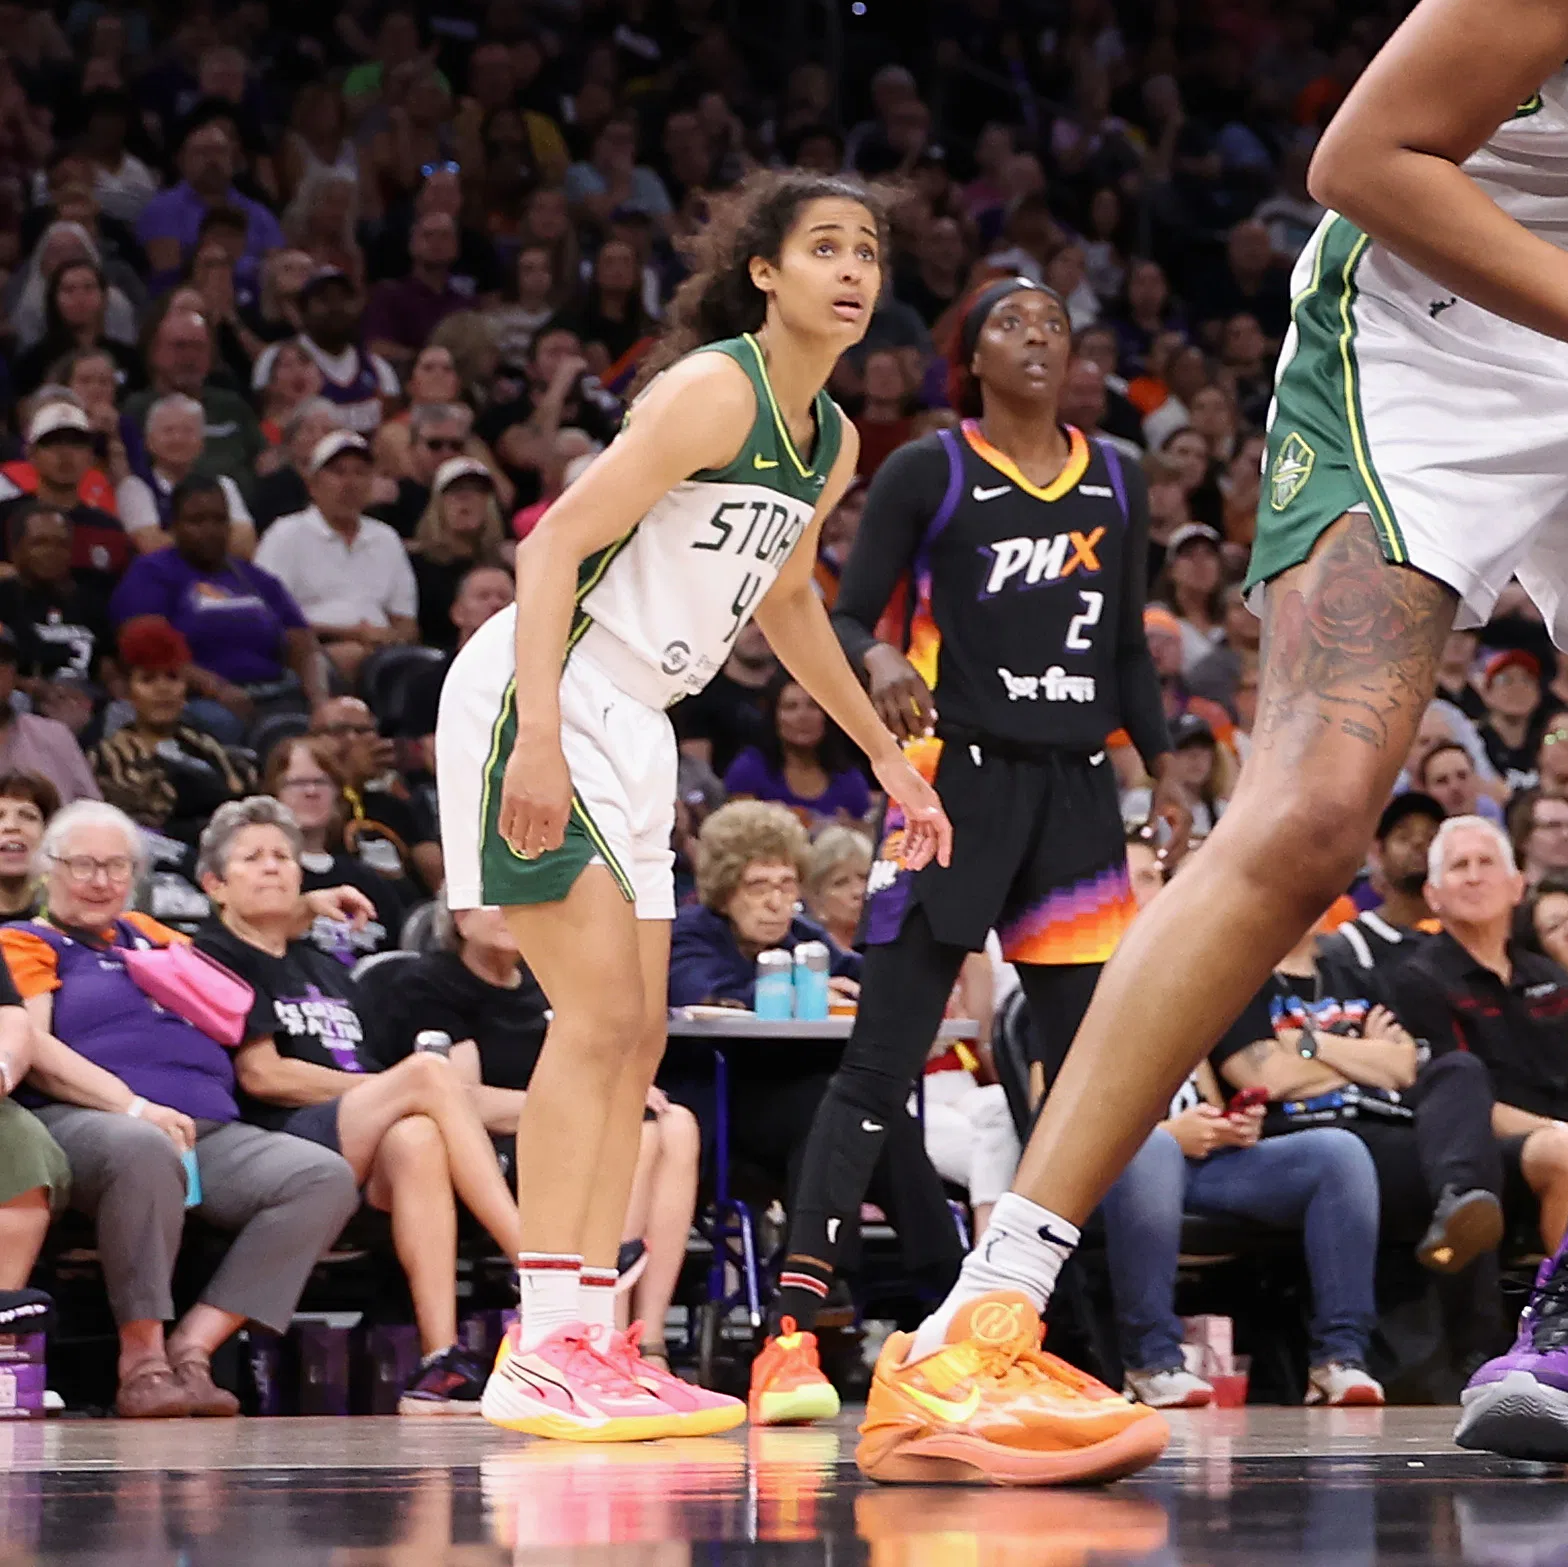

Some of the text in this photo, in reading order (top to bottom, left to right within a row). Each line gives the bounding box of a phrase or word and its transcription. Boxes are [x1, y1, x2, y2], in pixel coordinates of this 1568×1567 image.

[986, 526, 1107, 594] PHX
[723, 572, 762, 643] 4
[1064, 589, 1104, 650] 2
